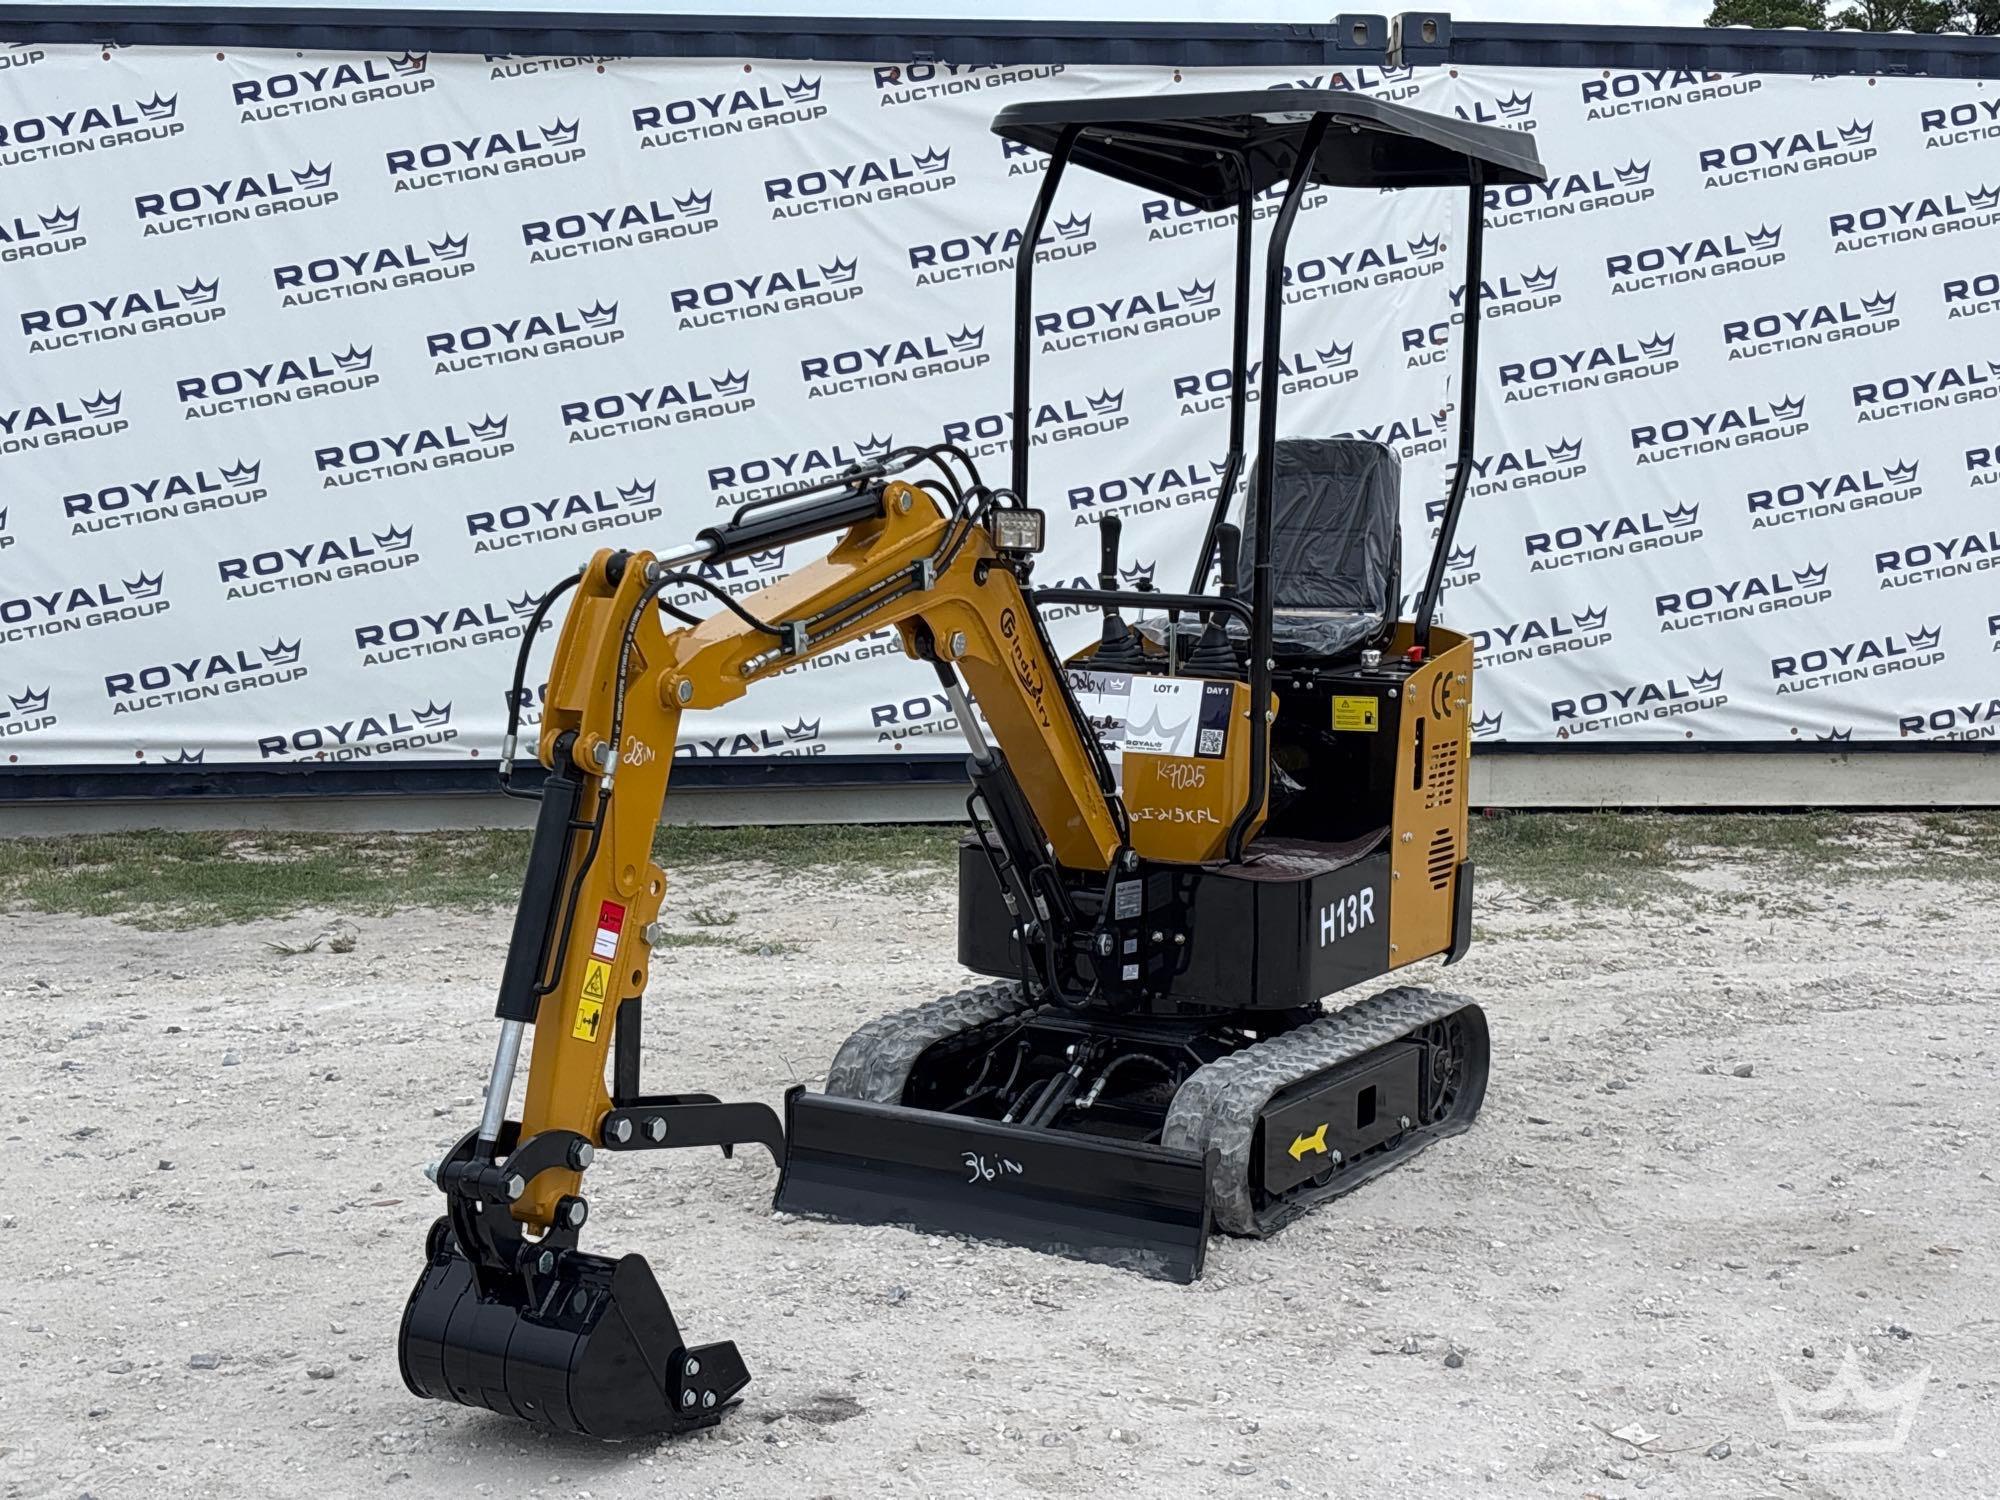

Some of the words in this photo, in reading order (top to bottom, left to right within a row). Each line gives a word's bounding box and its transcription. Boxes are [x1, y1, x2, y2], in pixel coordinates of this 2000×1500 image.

[232, 60, 389, 104] ROYAL
[241, 94, 346, 123] AUCTION
[352, 79, 433, 103] GROUP
[882, 79, 980, 107] AUCTION
[986, 64, 1062, 87] GROUP
[1587, 94, 1682, 121] AUCTION
[1687, 80, 1761, 103] GROUP
[633, 87, 784, 130] ROYAL
[641, 121, 742, 148] AUCTION
[748, 105, 827, 129] GROUP
[0, 139, 95, 168] UCTION
[100, 123, 183, 148] GROUP
[386, 130, 541, 174] ROYAL
[1699, 130, 1838, 171] ROYAL
[1926, 124, 2000, 149] AUCTIO
[395, 164, 499, 192] AUCTION
[504, 148, 585, 173] GROUP
[765, 158, 913, 202] ROYAL
[1705, 162, 1799, 188] AUCTION
[1804, 148, 1876, 170] GROUP
[135, 173, 293, 218] ROYAL
[144, 208, 250, 236] AUCTION
[255, 192, 338, 216] GROUP
[773, 192, 872, 220] AUCTION
[877, 176, 955, 200] GROUP
[1483, 203, 1574, 229] AUCTION
[1579, 188, 1654, 211] GROUP
[1830, 195, 1966, 236] ROYAL
[522, 201, 675, 245] ROYAL
[531, 235, 633, 263] AUCTION
[638, 219, 718, 243] GROUP
[1835, 227, 1927, 253] AUCTION
[1932, 212, 2000, 235] GROUP
[2, 237, 86, 261] GROUP
[274, 245, 430, 289] ROYAL
[917, 258, 1014, 286] AUCTION
[1036, 242, 1096, 266] ROUP
[1606, 236, 1746, 277] ROYAL
[283, 279, 387, 307] AUCTION
[393, 263, 474, 287] GROUP
[671, 268, 821, 312] ROYAL
[1373, 262, 1447, 286] GROUP
[1612, 268, 1706, 294] AUCTION
[1711, 253, 1785, 276] GROUP
[21, 289, 180, 335] ROYAL
[679, 302, 779, 330] AUCTION
[785, 286, 863, 310] GROUP
[1037, 291, 1179, 336] ROYAL
[1486, 295, 1561, 318] GROUP
[1723, 302, 1861, 343] ROYAL
[30, 324, 136, 353] AUCTION
[142, 307, 225, 332] GROUP
[427, 312, 580, 357] ROYAL
[1043, 324, 1139, 353] AUCTION
[1144, 308, 1219, 332] GROUP
[1729, 334, 1822, 360] AUCTION
[1827, 319, 1899, 341] GROUP
[436, 346, 538, 374] AUCTION
[544, 330, 624, 354] GROUP
[801, 337, 948, 381] ROYAL
[1499, 344, 1639, 386] ROYAL
[177, 357, 334, 402] ROYAL
[186, 391, 291, 420] AUCTION
[297, 374, 379, 399] GROUP
[809, 370, 907, 398] AUCTION
[912, 354, 989, 378] GROUP
[1282, 371, 1356, 394] GROUP
[1505, 376, 1599, 403] AUCTION
[1604, 360, 1678, 384] GROUP
[1853, 365, 1988, 406] ROYAL
[561, 381, 712, 425] ROYAL
[570, 415, 671, 443] AUCTION
[676, 398, 755, 423] GROUP
[1858, 396, 1949, 423] AUCTION
[1954, 383, 2000, 404] GRO
[44, 420, 128, 445] GROUP
[315, 426, 470, 471] ROYAL
[1052, 417, 1128, 441] GROUP
[1631, 406, 1770, 448] ROYAL
[1637, 438, 1730, 465] AUCTION
[1735, 423, 1808, 446] GROUP
[324, 460, 427, 488] AUCTION
[433, 443, 514, 468] GROUP
[708, 445, 856, 490] ROYAL
[1068, 465, 1211, 509] ROYAL
[1512, 465, 1586, 488] GROUP
[63, 472, 222, 517] ROYAL
[72, 506, 178, 535] AUCTION
[184, 489, 266, 514] GROUP
[467, 491, 619, 535] ROYAL
[1747, 471, 1884, 512] ROYAL
[1753, 502, 1845, 529] AUCTION
[1850, 487, 1922, 510] GROUP
[475, 524, 577, 552] AUCTION
[582, 507, 661, 531] GROUP
[1525, 513, 1664, 555] ROYAL
[1531, 545, 1624, 572] AUCTION
[1629, 529, 1702, 552] GROUP
[218, 537, 375, 582] ROYAL
[1875, 531, 2000, 573] ROYAL
[227, 570, 332, 600] AUCTION
[337, 553, 419, 578] GROUP
[1655, 574, 1793, 616] ROYAL
[1881, 562, 1971, 589] AUCTION
[0, 584, 125, 630] OYAL
[0, 618, 81, 648] CTION
[87, 601, 170, 626] GROUP
[355, 604, 509, 649] ROYAL
[1661, 605, 1754, 632] AUCTION
[1759, 590, 1831, 613] GROUP
[364, 637, 467, 666] AUCTION
[1472, 617, 1572, 659] OYAL
[1473, 648, 1532, 669] CTION
[1537, 633, 1611, 656] GROUP
[1771, 637, 1907, 679] ROYAL
[105, 651, 262, 697] ROYAL
[114, 685, 219, 714] AUCTION
[225, 667, 307, 693] GROUP
[1153, 683, 1172, 694] LOT
[1206, 686, 1224, 696] DAY
[1224, 687, 1230, 696] 1
[1777, 668, 1868, 695] AUCTION
[1873, 652, 1944, 675] GROUP
[1551, 680, 1689, 721] ROYAL
[1557, 710, 1649, 736] AUCTION
[1654, 695, 1727, 717] GROUP
[1899, 700, 2000, 737] ROYA
[258, 713, 413, 759] ROYAL
[376, 729, 457, 754] GROUP
[878, 717, 958, 743] AUCTIO
[1126, 739, 1155, 748] ROYAL
[1320, 886, 1375, 948] H13R
